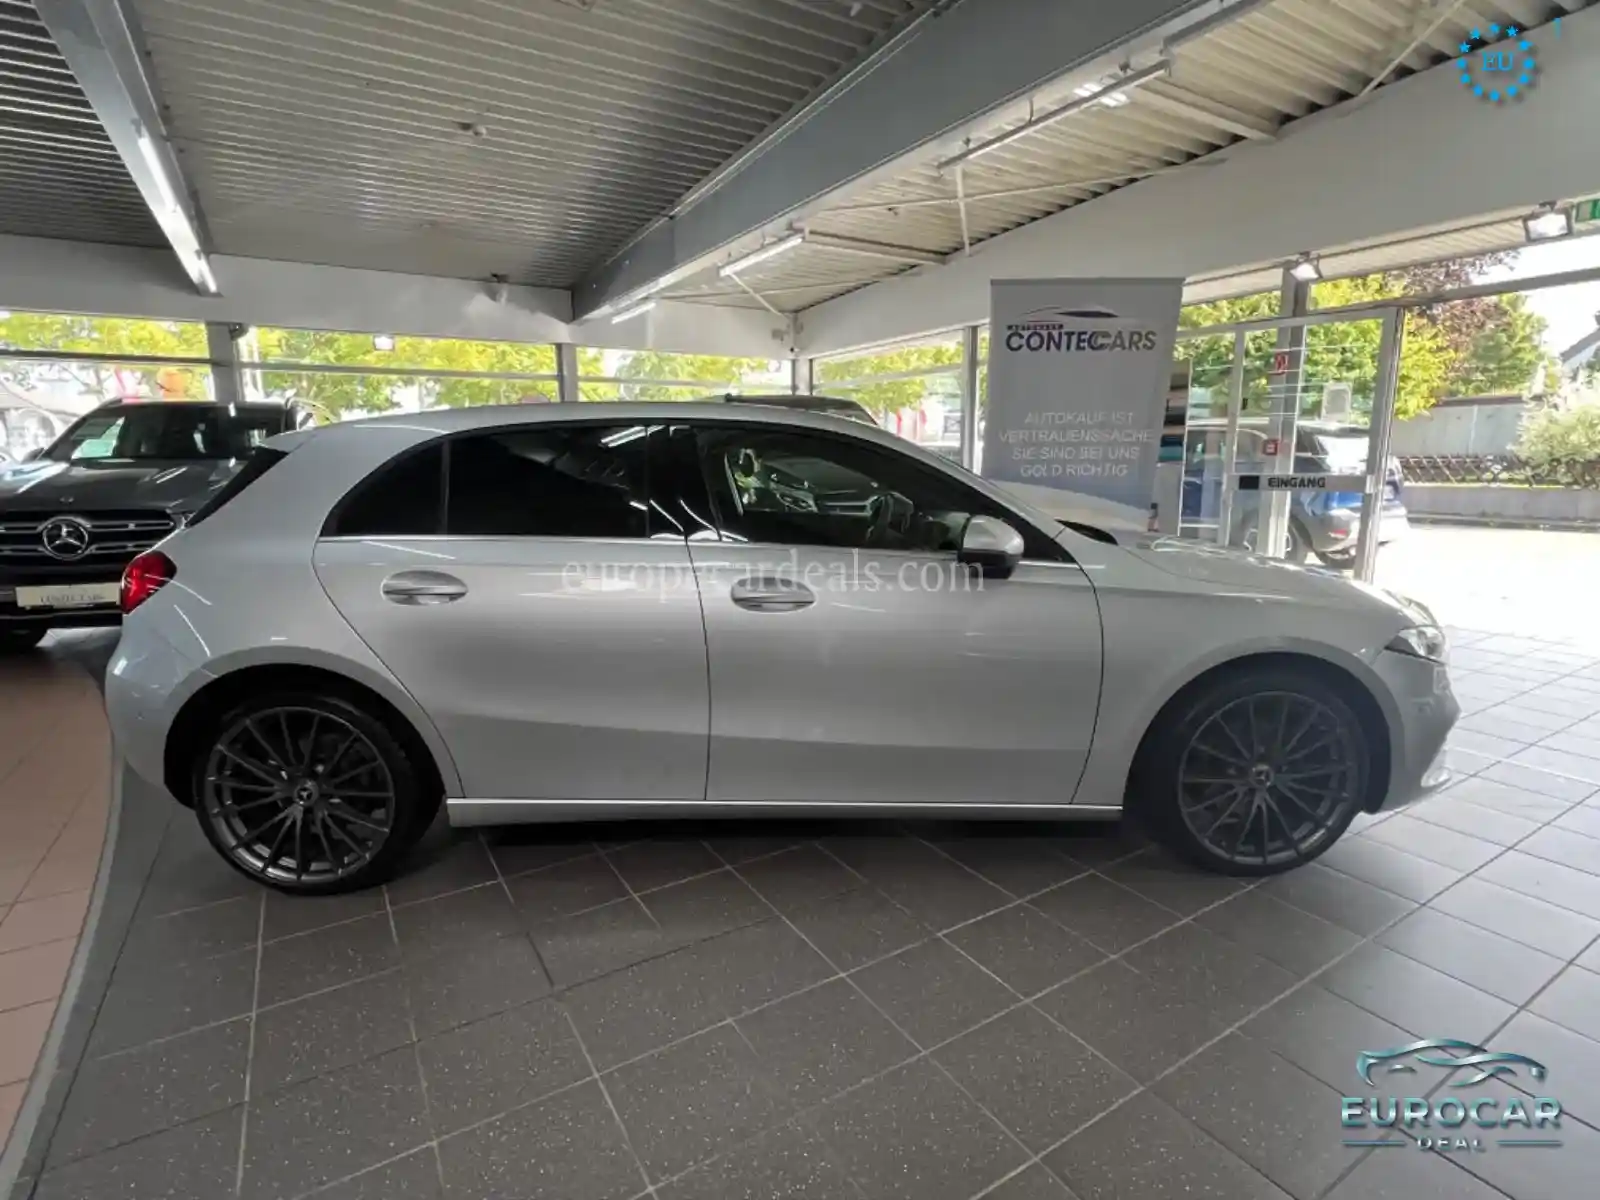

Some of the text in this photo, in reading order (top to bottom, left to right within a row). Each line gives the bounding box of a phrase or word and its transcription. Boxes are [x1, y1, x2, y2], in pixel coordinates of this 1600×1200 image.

[1111, 411, 1134, 425] IST
[1012, 447, 1036, 460] SIE
[1040, 447, 1076, 460] SIND
[1108, 447, 1140, 460] UNS
[1020, 463, 1128, 477] GOLD RICHTIG
[1267, 476, 1326, 488] EINGANG
